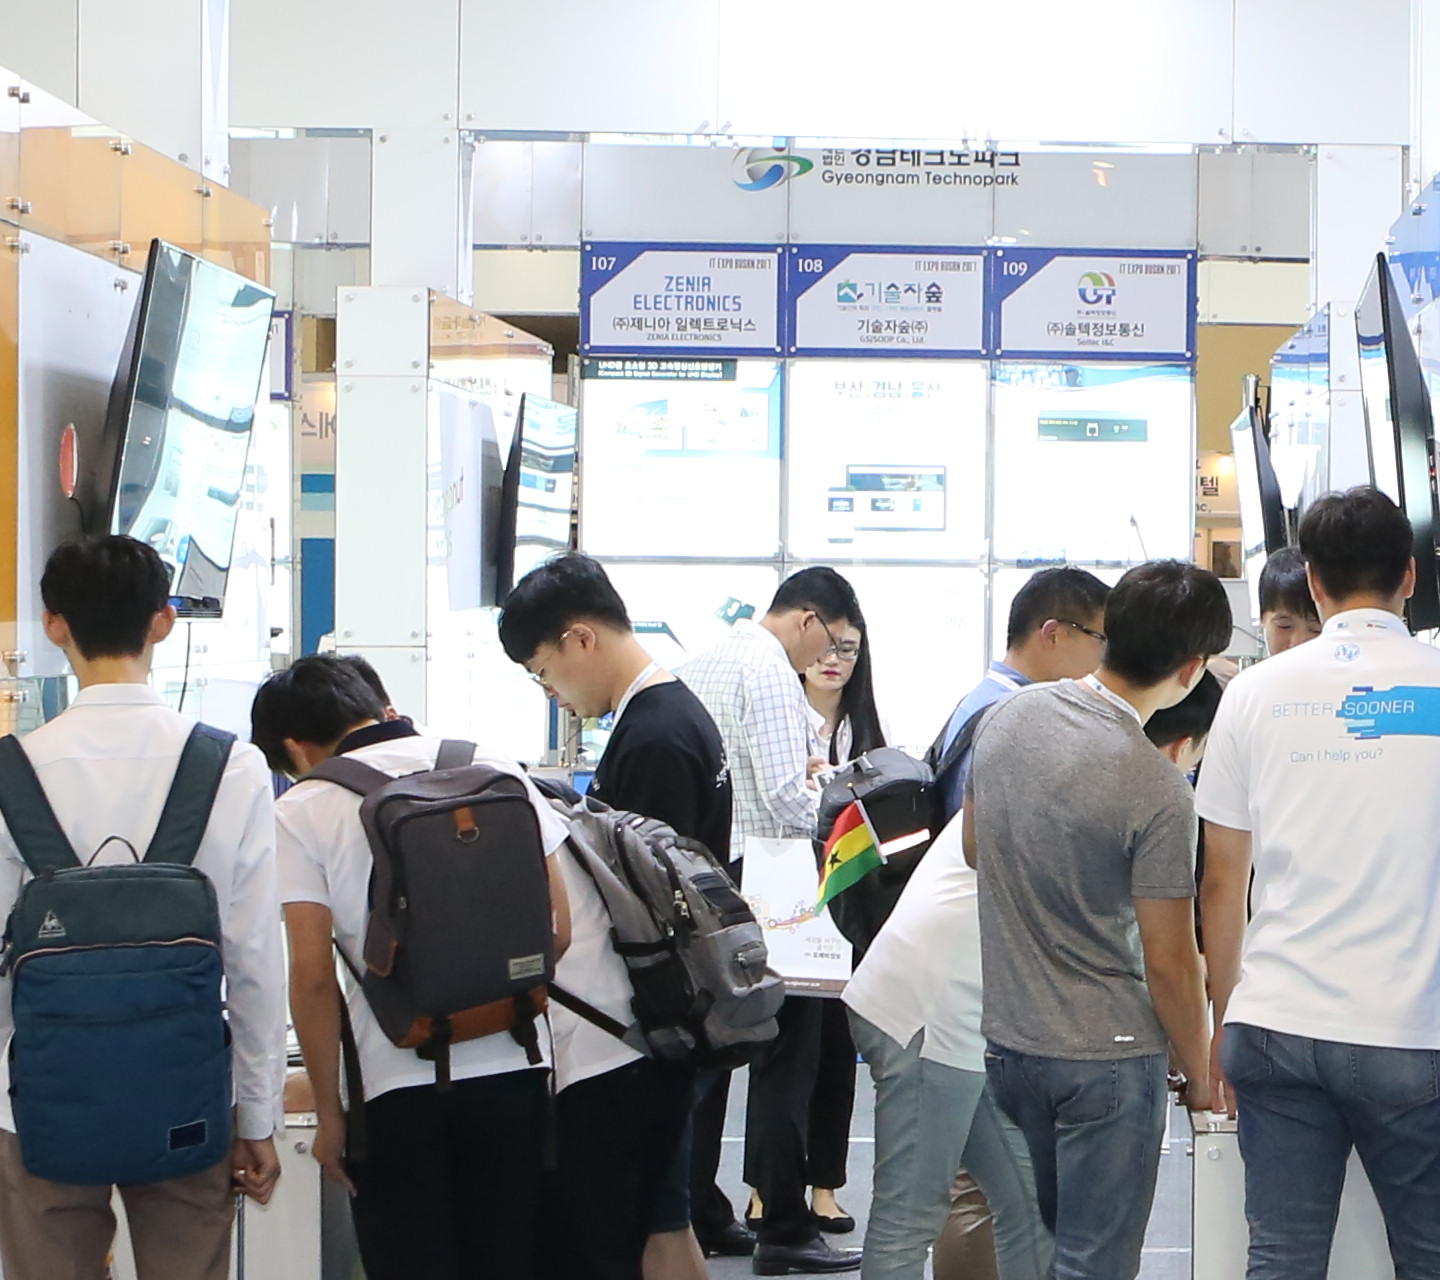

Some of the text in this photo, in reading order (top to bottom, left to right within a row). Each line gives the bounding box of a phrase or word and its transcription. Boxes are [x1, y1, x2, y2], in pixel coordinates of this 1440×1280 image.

[821, 170, 1019, 187] Gyeongnam Technopark
[664, 275, 711, 292] ZENIA
[865, 281, 943, 304] 기술자숲
[633, 294, 742, 312] ELECTRONICS
[675, 317, 757, 332] 일렉트로닉스
[1272, 700, 1415, 718] BETTER SOONER
[1291, 751, 1313, 763] Can
[1324, 748, 1350, 763] help
[1354, 747, 1384, 763] you?
